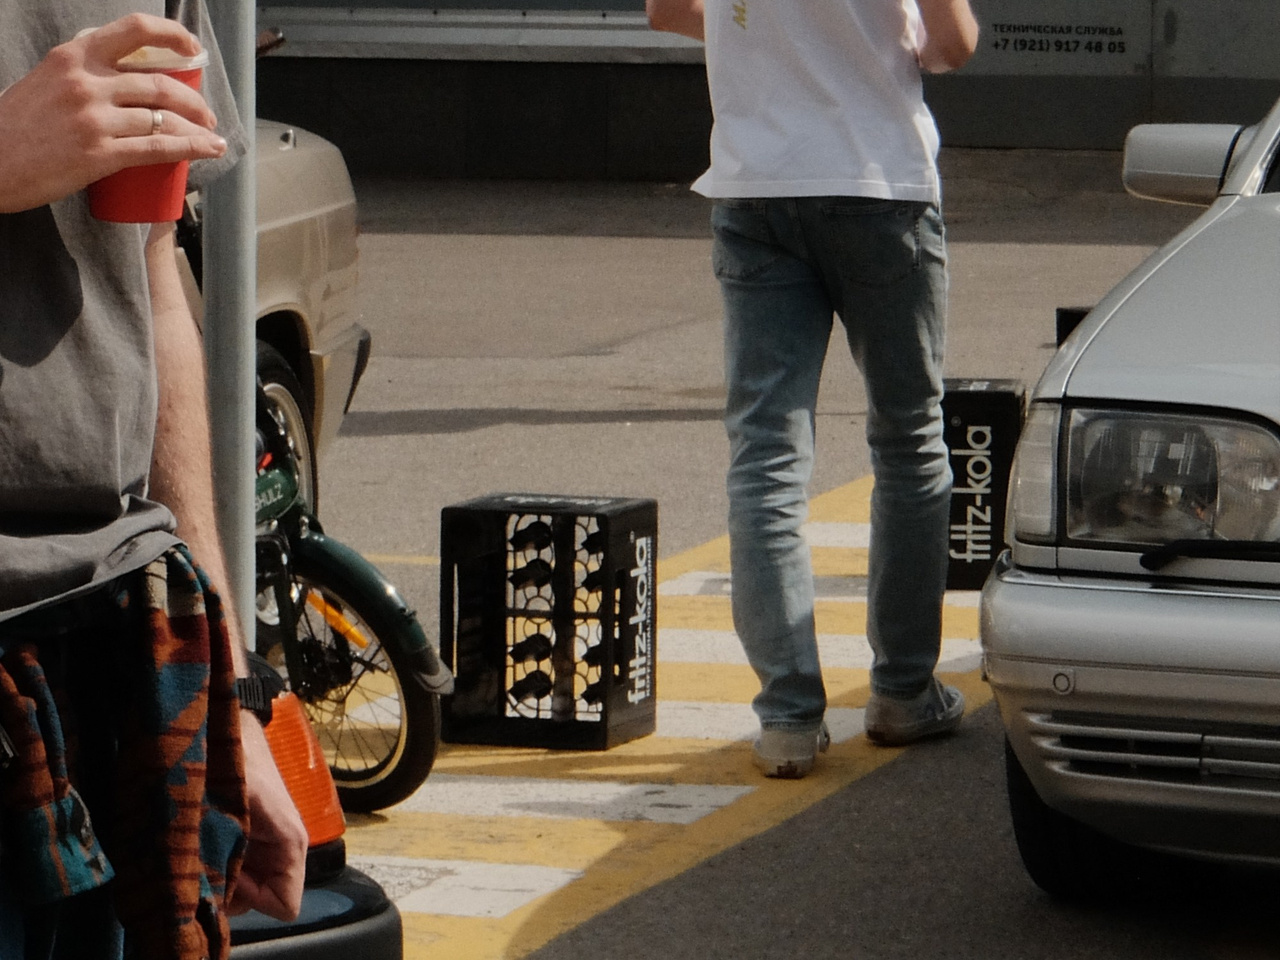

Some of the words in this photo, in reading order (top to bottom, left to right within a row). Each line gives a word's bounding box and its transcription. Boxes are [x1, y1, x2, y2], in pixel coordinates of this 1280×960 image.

[992, 24, 1072, 34] ТЕХНИЧЕСКАЯ
[1075, 25, 1123, 36] СЛУЖБА
[994, 39, 1010, 50] +7
[1013, 39, 1050, 52] (921)
[1054, 40, 1080, 52] 917
[1107, 41, 1126, 53] 05
[949, 426, 992, 563] fritz-kola
[627, 536, 647, 705] fritz-kola
